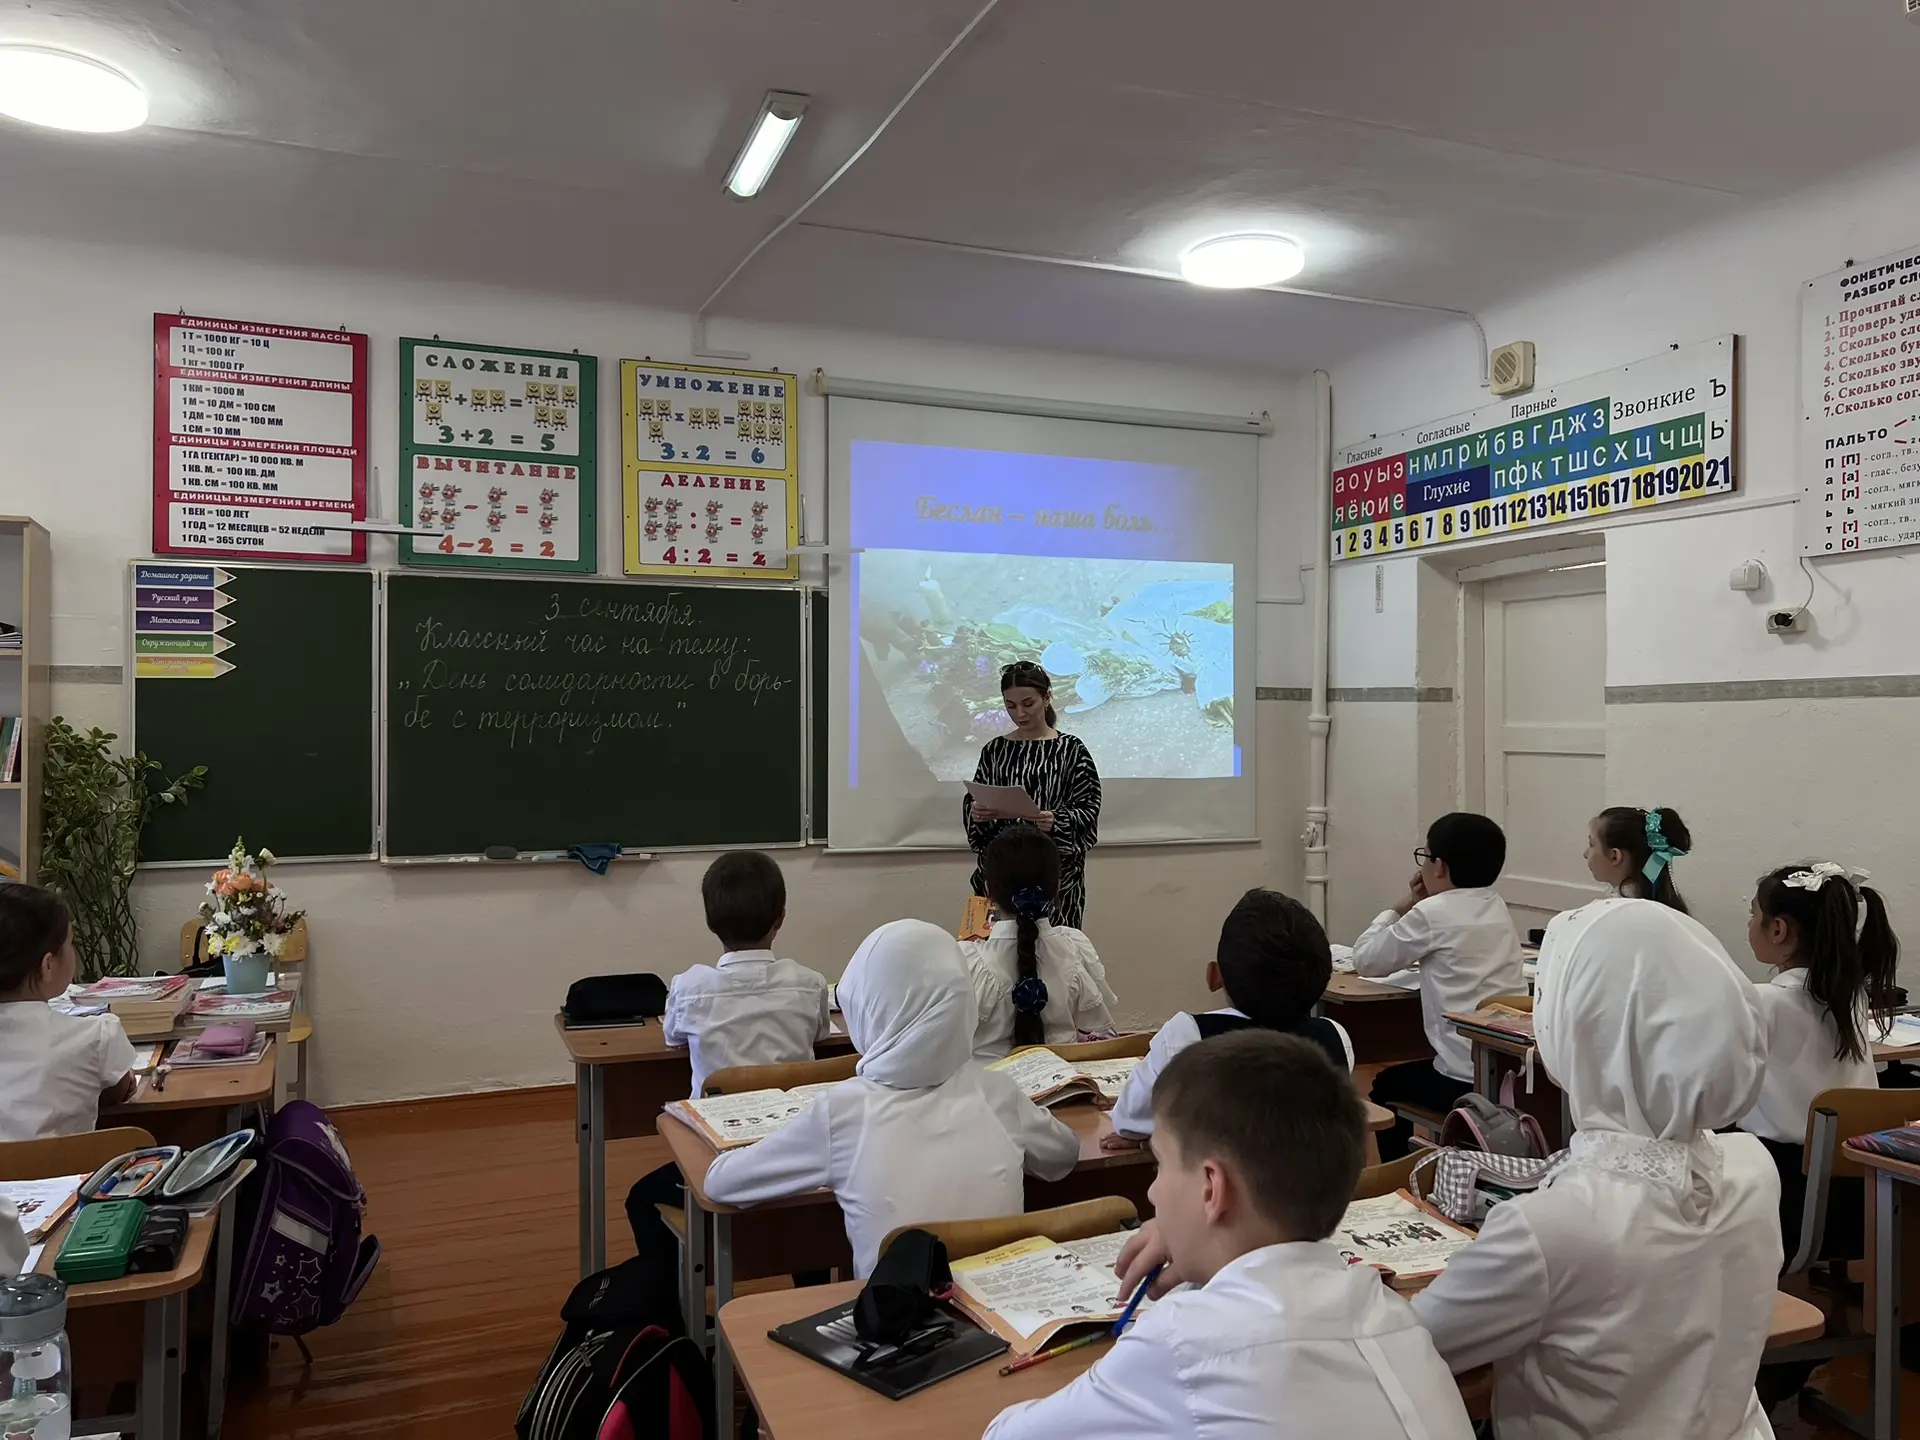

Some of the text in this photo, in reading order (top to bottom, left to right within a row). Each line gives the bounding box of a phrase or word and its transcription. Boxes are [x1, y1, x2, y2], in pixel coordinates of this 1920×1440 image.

[1844, 279, 1895, 302] РАЗБОР
[1824, 315, 1835, 327] 1.
[1839, 292, 1906, 324] Прочитай
[180, 318, 350, 342] ЕДИНИЦЫ ИЗМЕРЕНИЯ МАССЫ
[1824, 331, 1835, 343] 2.
[1839, 315, 1896, 338] Проверь
[204, 334, 228, 344] 1000
[229, 336, 241, 345] КГ
[250, 339, 261, 347] 10
[263, 340, 270, 349] Ц
[205, 346, 222, 356] 100
[224, 348, 236, 357] КГ
[1824, 346, 1835, 357] 3.
[1839, 330, 1897, 353] Сколько
[1824, 361, 1835, 372] 4.
[1839, 345, 1897, 369] Сколько
[180, 368, 350, 390] ЕДИНИЦЫ ИЗМЕРЕНИЯ ДЛИНЫ
[1824, 376, 1835, 388] 5.
[1839, 360, 1897, 384] Сколько
[188, 384, 203, 393] КМ
[213, 386, 236, 396] 1000
[236, 388, 245, 396] М
[639, 374, 785, 398] УМНОЖЕНИЕ
[1824, 391, 1835, 403] 6.
[1838, 376, 1897, 399] Сколько
[1511, 396, 1558, 419] Парные
[1613, 386, 1696, 420] Звонкие
[438, 425, 455, 444] 3
[478, 428, 494, 446] 2
[540, 433, 555, 451] 5
[1416, 421, 1471, 444] Согласные
[1825, 428, 1888, 450] ПАЛЬТО
[171, 435, 357, 456] ЕДИНИЦЫ ИЗМЕРЕНИЯ ПЛОЩАДИ
[660, 442, 675, 460] 3
[696, 445, 710, 461] 2
[751, 447, 765, 464] 6
[1346, 446, 1383, 465] Гласные
[417, 456, 576, 480] ВЫЧИТАНИЕ
[661, 473, 766, 492] ДЕЛЕНИЕ
[1423, 480, 1471, 502] Глухие
[173, 491, 355, 510] ЕДИНИЦЫ ИЗМЕРЕНИЯ ВРЕМЕНИ
[915, 495, 1003, 525] Беслан
[1033, 508, 1097, 528] наша
[1335, 455, 1730, 555] 1 2 3 4 5 6 7 8 9 10 11 12 13 14 15 16 17 18 19 20 21
[1870, 498, 1906, 511] мягкий
[188, 507, 206, 516] ВЕК
[215, 509, 231, 518] 100
[233, 510, 250, 519] ЛЕТ
[188, 521, 207, 531] ГОД
[216, 522, 226, 531] 12
[228, 523, 269, 533] МЕСЯЦЕВ
[279, 526, 290, 535] 52
[438, 534, 454, 554] 4
[477, 537, 494, 555] 2
[539, 541, 555, 558] 2
[662, 546, 677, 564] 4
[697, 548, 712, 565] 2
[752, 551, 766, 566] 2
[140, 570, 209, 582] Домашнее задание
[151, 593, 199, 605] Русский язык
[544, 593, 560, 621] 3
[149, 615, 200, 625] Математика
[142, 638, 208, 650] Окружающий мир
[415, 616, 751, 675] Классный час на тему:
[505, 672, 694, 705] солидарности
[709, 659, 722, 690] в
[404, 694, 433, 729] бе
[452, 709, 467, 729] с
